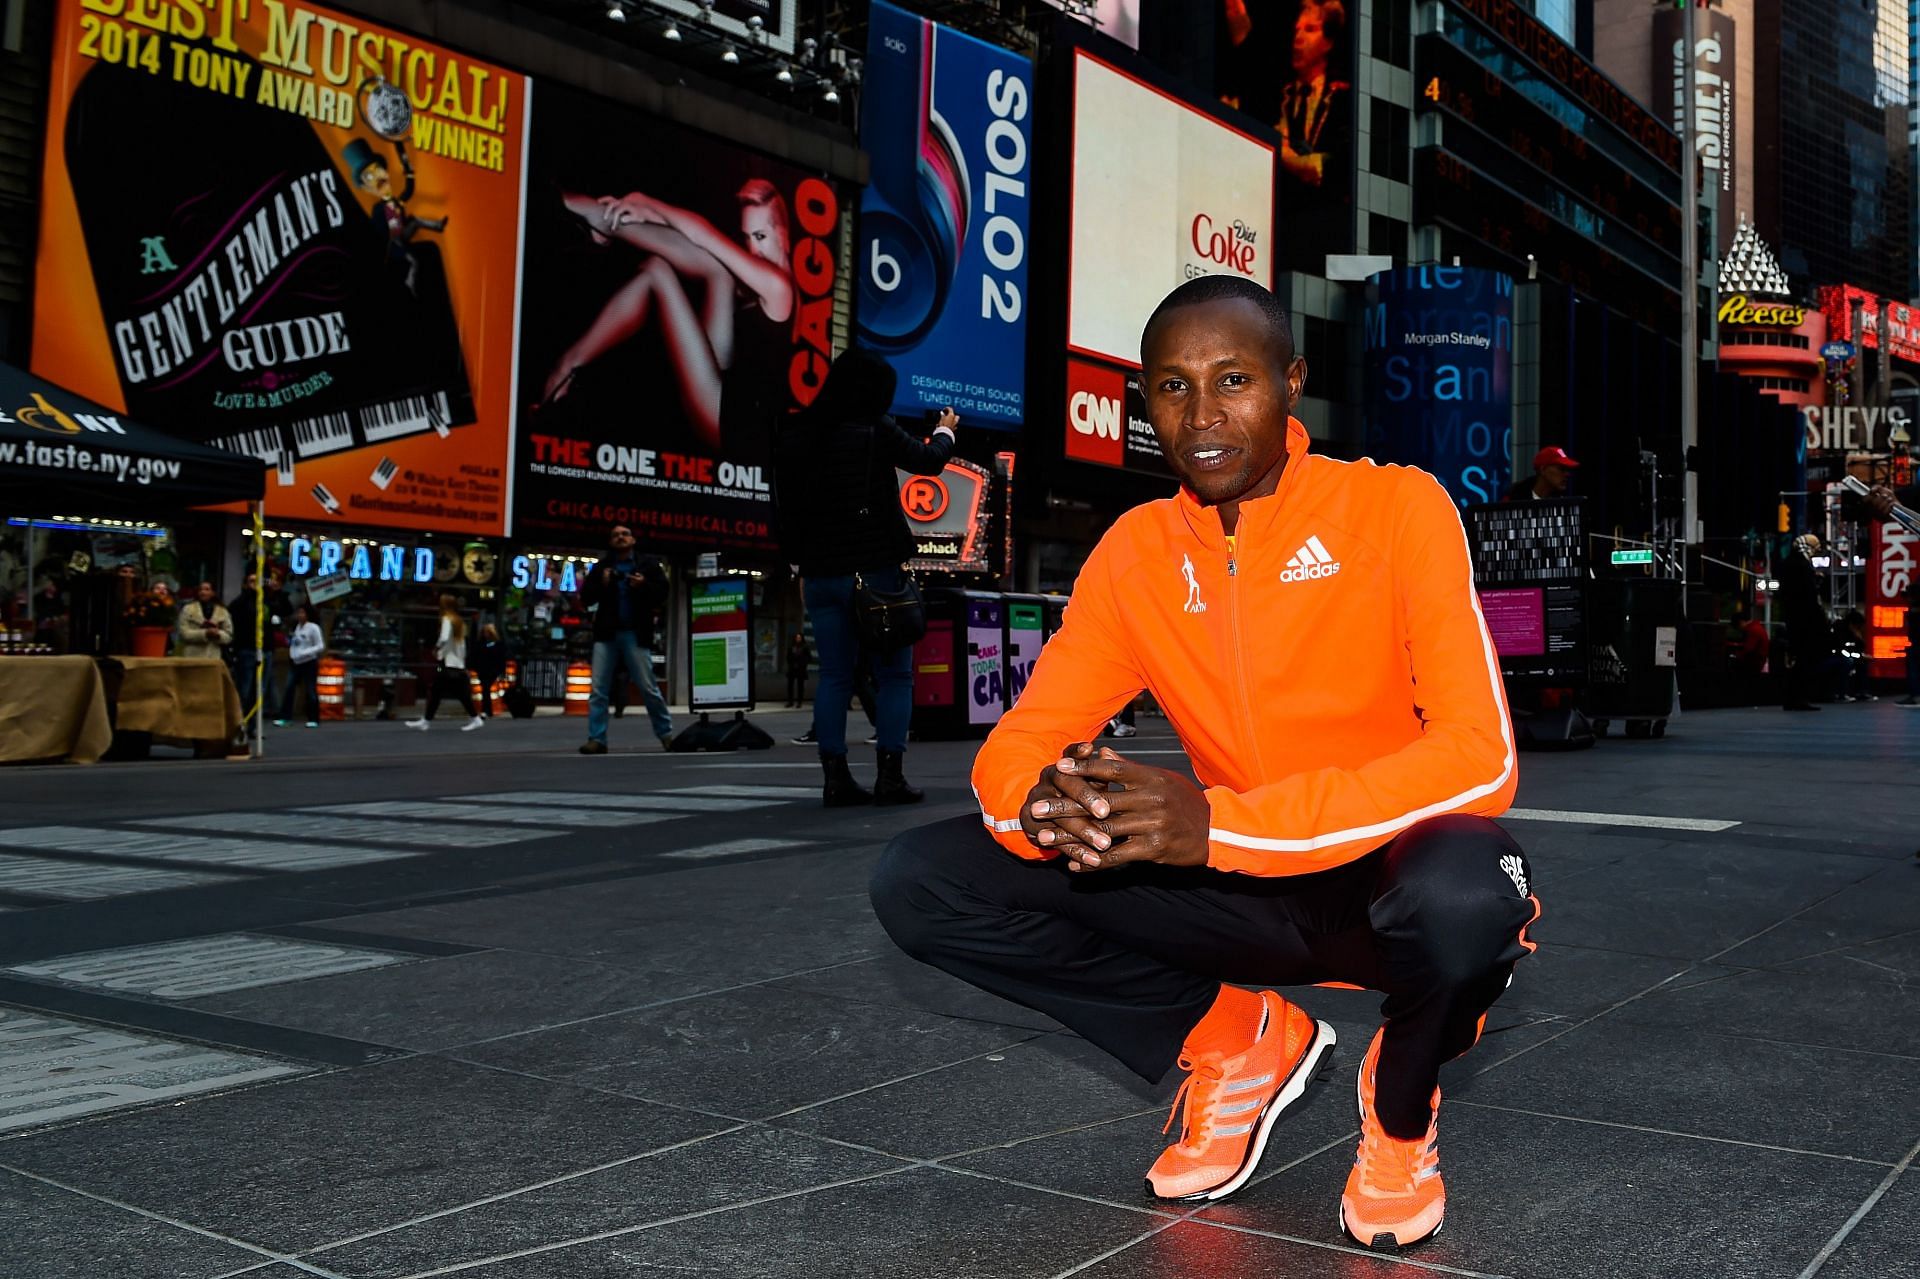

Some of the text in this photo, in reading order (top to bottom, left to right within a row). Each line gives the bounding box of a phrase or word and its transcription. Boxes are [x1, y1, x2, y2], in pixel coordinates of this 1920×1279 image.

[884, 36, 907, 54] solo
[81, 0, 508, 134] EST MUSICAL!
[78, 14, 504, 172] 2014 TONY AWARD WINNER
[1424, 76, 1441, 102] 4
[1722, 80, 1731, 191] MILK CHOCOLATE
[1192, 214, 1255, 275] Coke
[1233, 219, 1256, 243] Diet
[140, 235, 179, 274] A
[114, 168, 344, 384] GENTLEMAN'S
[1185, 264, 1208, 279] GE
[1718, 293, 1806, 325] Reese's
[222, 310, 351, 373] GUIDE
[1405, 332, 1491, 349] Morgan Stanley
[213, 390, 256, 411] LOVE
[912, 375, 963, 393] DESIGNED
[965, 384, 985, 397] FOR
[918, 391, 952, 406] TUNED
[954, 397, 974, 410] FOR
[72, 412, 127, 434] NY
[1069, 390, 1121, 441] CNN
[530, 433, 770, 492] THE ONE THE ONL
[530, 462, 546, 474] THE
[628, 475, 669, 489] AMERICAN
[669, 481, 702, 493] MUSICAL
[546, 498, 769, 538] CHICAGOTHEMUSICAL.COM
[290, 538, 435, 584] GRAND
[512, 553, 595, 592] SLA
[1280, 561, 1340, 583] adidas
